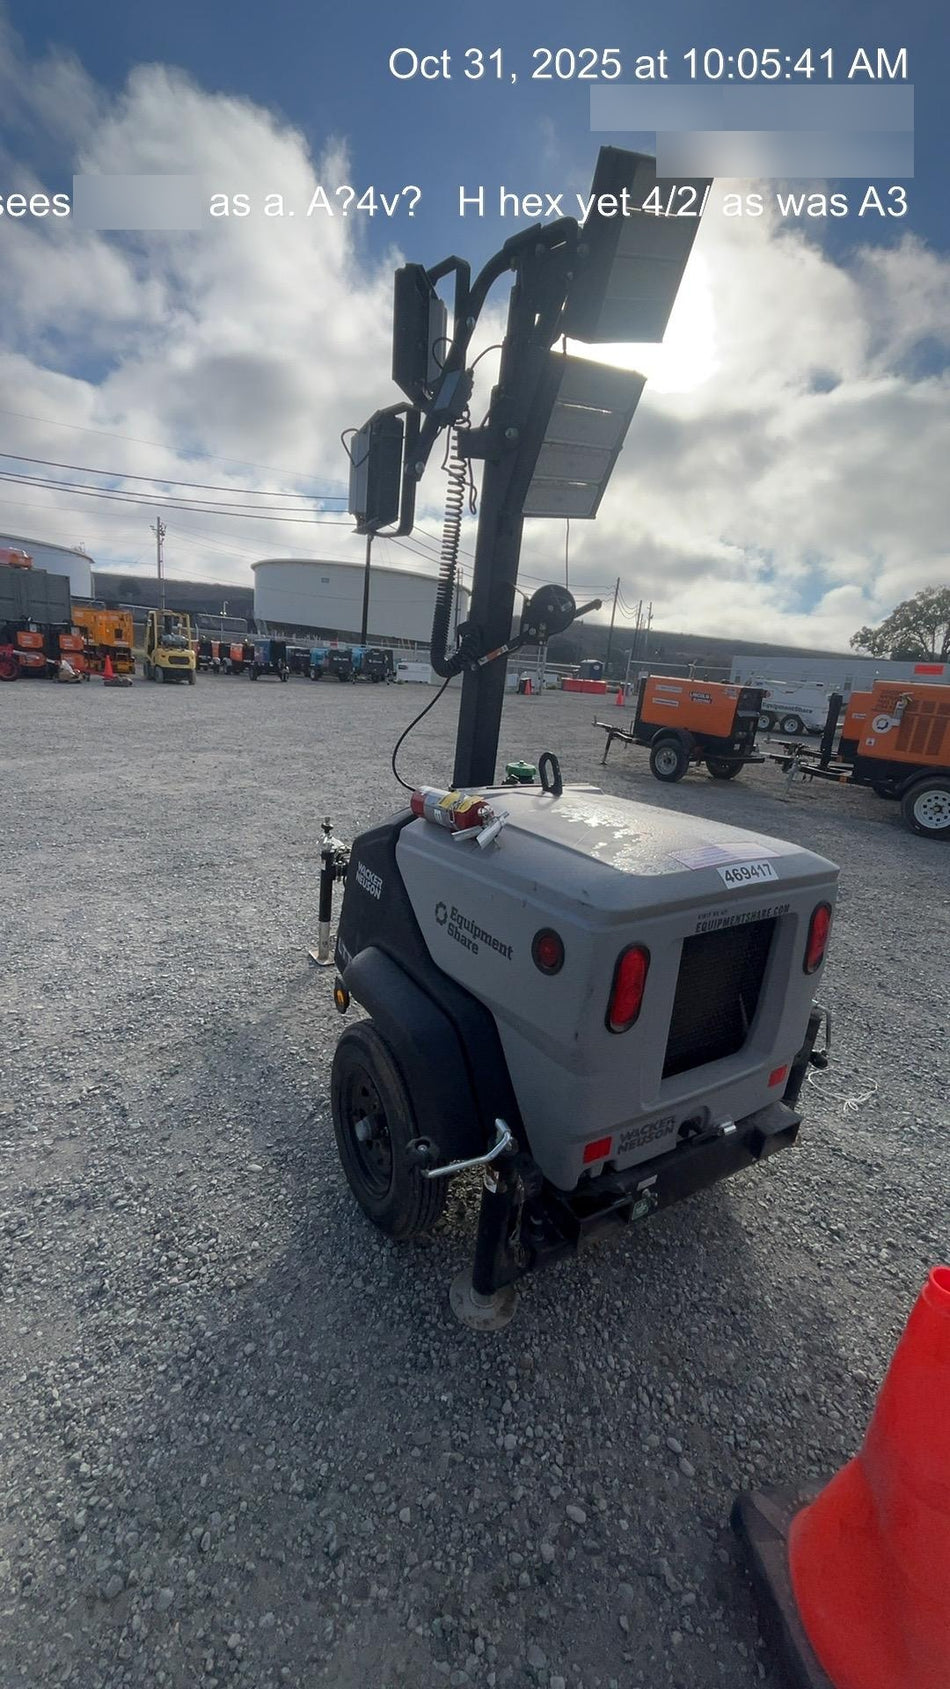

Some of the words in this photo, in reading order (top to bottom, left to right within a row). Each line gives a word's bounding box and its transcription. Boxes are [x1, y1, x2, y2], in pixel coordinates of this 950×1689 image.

[356, 871, 381, 900] NEUSON
[357, 861, 382, 890] WACKER
[724, 863, 773, 883] 469417
[447, 922, 479, 955] Share
[450, 906, 513, 961] Equipment
